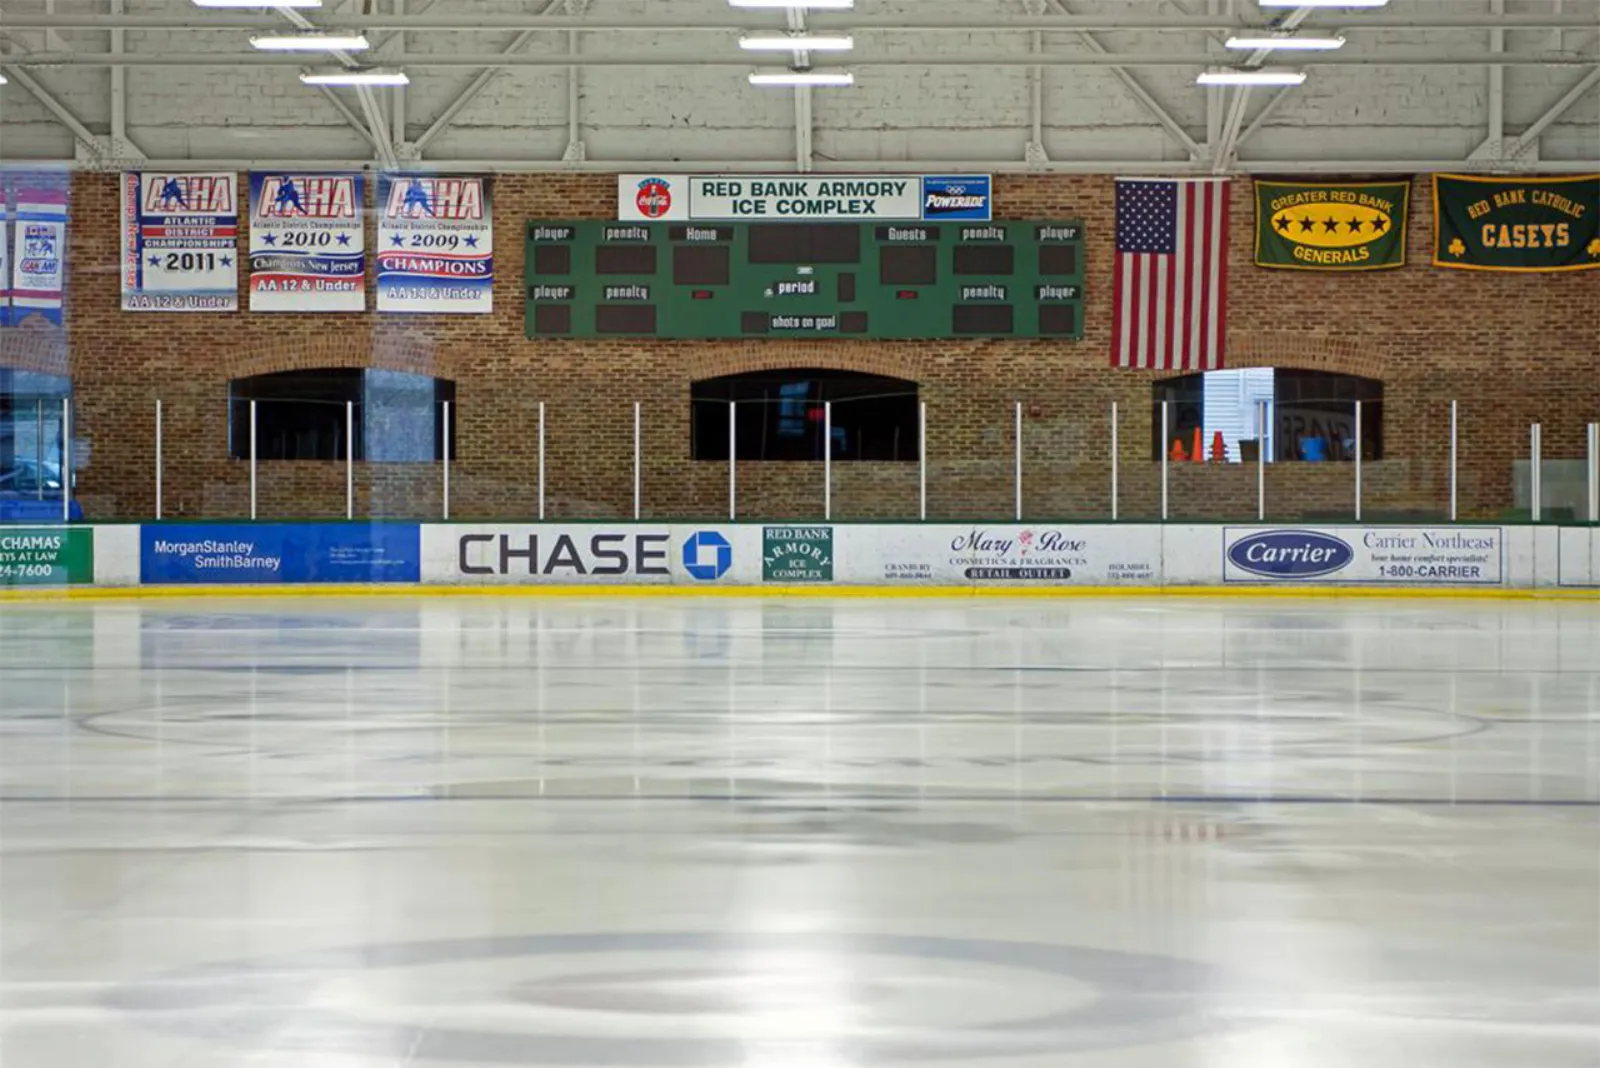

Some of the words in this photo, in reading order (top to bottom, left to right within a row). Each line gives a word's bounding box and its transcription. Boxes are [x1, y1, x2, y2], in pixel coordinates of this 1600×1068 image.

[702, 182, 742, 197] RED
[750, 182, 808, 197] BANK
[818, 182, 907, 197] ARMORY
[732, 199, 766, 214] ICE
[776, 199, 876, 214] COMPLEX
[1271, 191, 1328, 210] GREATER
[1330, 191, 1356, 202] RED
[1359, 194, 1393, 213] BANK
[1467, 199, 1491, 219] RED
[1493, 189, 1525, 208] BANK
[1532, 190, 1585, 218] CATHOLIC
[164, 217, 216, 225] ATLANTIC
[165, 228, 214, 236] DISTRICT
[282, 232, 331, 246] 2010
[534, 228, 569, 240] player
[607, 227, 648, 241] penalty
[686, 228, 717, 240] Home
[888, 228, 926, 240] Guests
[962, 227, 1004, 241] penalty
[1040, 227, 1075, 240] player
[1482, 223, 1570, 247] CASEYS
[145, 240, 234, 248] CHAMPIONSHIPS
[411, 234, 459, 250] 2009
[166, 253, 214, 270] 2011
[1293, 246, 1370, 264] GENERALS
[308, 260, 328, 271] New
[330, 260, 359, 273] Jersey
[383, 258, 486, 274] CHAMPIONS
[257, 280, 278, 291] AA
[282, 280, 297, 291] 12
[300, 280, 311, 291] &
[315, 280, 357, 291] Under
[778, 280, 815, 295] period
[1039, 286, 1075, 299] player
[388, 287, 408, 299] AA
[429, 287, 440, 299] &
[443, 287, 481, 299] Under
[534, 287, 569, 299] player
[606, 286, 648, 300] penalty
[962, 286, 1004, 300] penalty
[129, 295, 151, 307] AA
[156, 296, 171, 307] 12
[174, 297, 185, 307] &
[189, 296, 230, 307] Under
[773, 315, 800, 328] shots
[802, 318, 814, 328] on
[816, 315, 836, 330] goal
[766, 529, 792, 539] RED
[795, 529, 829, 539] BANK
[1363, 531, 1417, 549] Carrier
[1422, 532, 1494, 549] Northeast
[1, 536, 61, 550] CHAMAS
[154, 540, 254, 556] MorganStanley
[951, 530, 1013, 557] Mary
[1035, 531, 1086, 551] Rose
[19, 552, 32, 561] AT
[35, 552, 58, 561] LAW
[459, 534, 671, 575] CHASE
[764, 542, 831, 568] ARMORY
[1246, 542, 1337, 562] Carrier
[194, 555, 281, 571] SmithBarney
[789, 559, 807, 568] ICE
[949, 557, 1007, 565] COSMETICS
[1009, 557, 1017, 565] &
[1019, 557, 1087, 566] FRAGRANCES
[772, 569, 822, 578] COMPLEX
[970, 568, 1011, 578] RETAIL
[1019, 568, 1066, 578] OUTLET
[1379, 564, 1480, 577] 1-800-CARRIER
